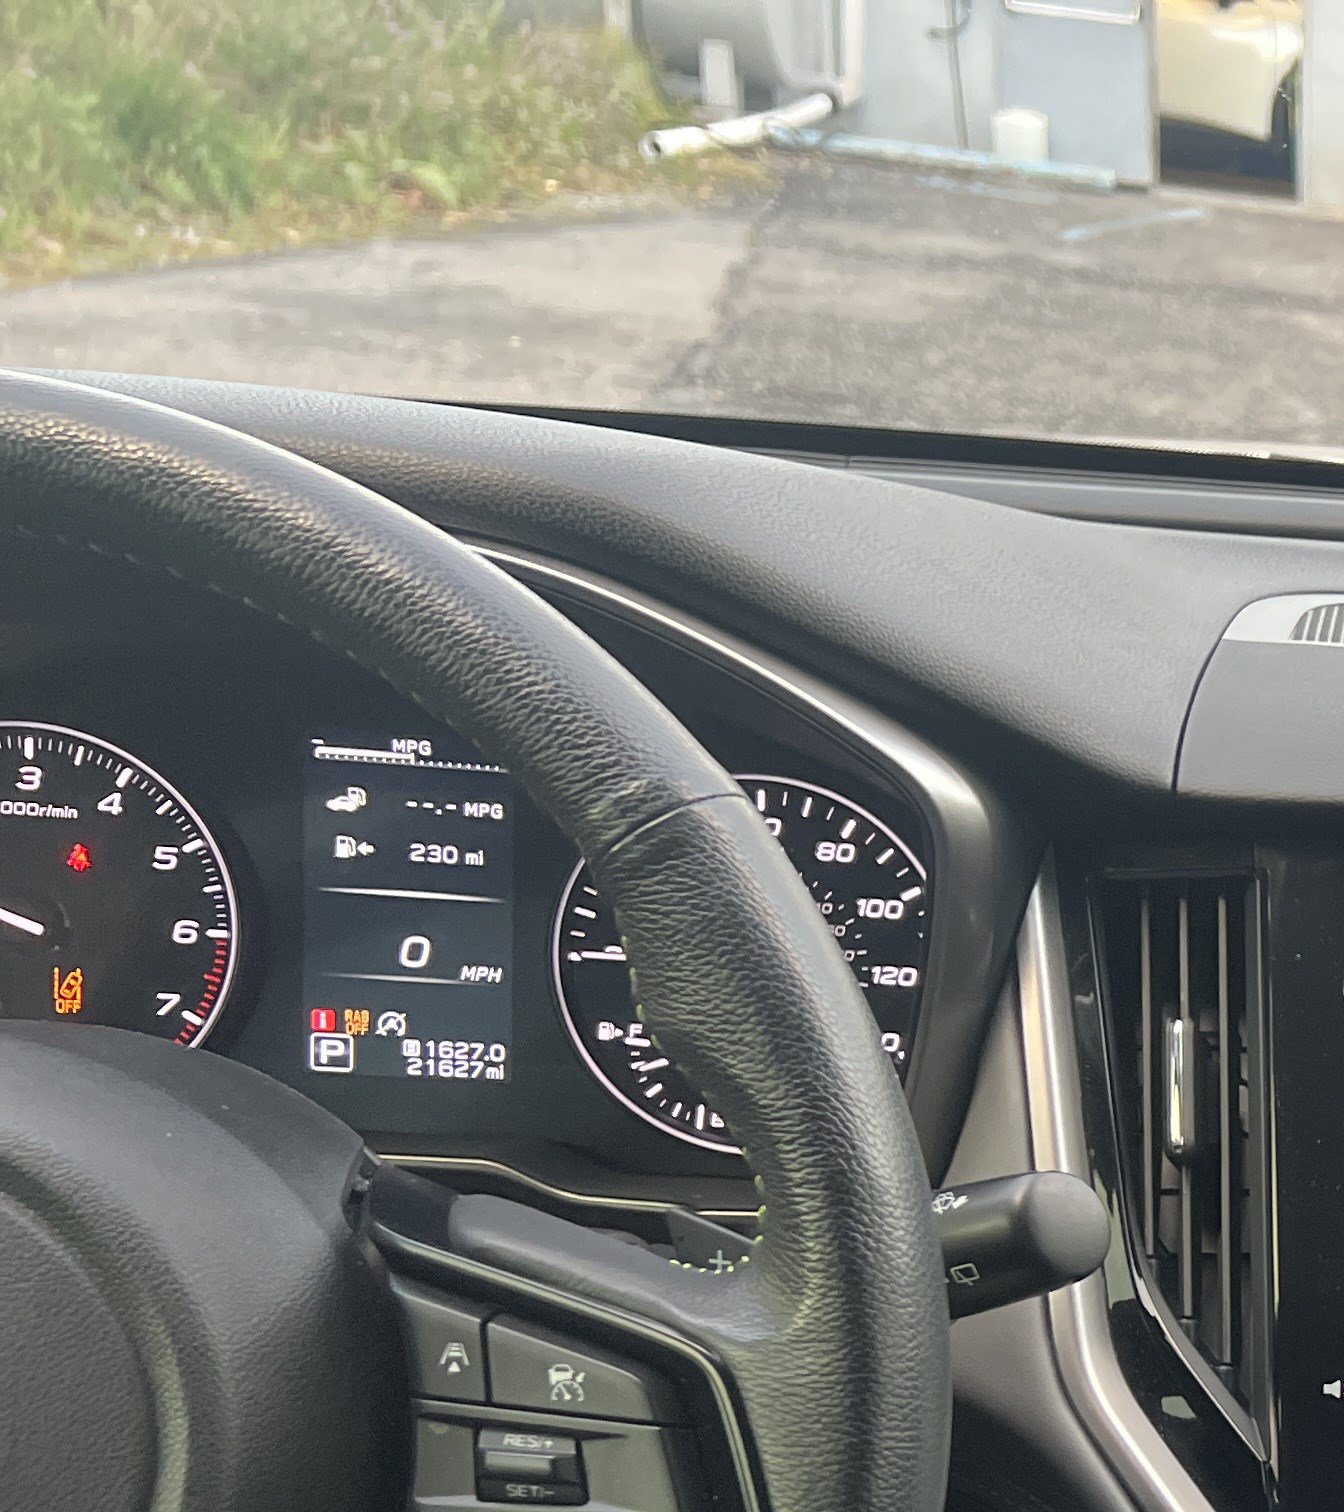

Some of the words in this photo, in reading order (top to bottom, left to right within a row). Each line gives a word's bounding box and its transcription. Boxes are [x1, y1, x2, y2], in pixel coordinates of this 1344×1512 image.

[391, 739, 432, 757] MPG
[15, 766, 42, 791] 3
[0, 800, 79, 819] 000r/min
[97, 792, 123, 816] 4
[463, 802, 504, 820] MPG
[153, 846, 179, 871] 5
[409, 841, 458, 865] 230
[465, 848, 485, 866] mi
[816, 842, 856, 864] 80
[857, 898, 905, 920] 100
[172, 919, 199, 944] 6
[399, 935, 431, 968] 0
[460, 965, 504, 984] MPH
[872, 966, 918, 987] 120
[55, 998, 82, 1014] OFF
[155, 993, 181, 1016] 7
[344, 1009, 370, 1024] RAB
[346, 1022, 370, 1036] OFF
[629, 1023, 644, 1038] F
[319, 1039, 346, 1065] P
[426, 1040, 507, 1063] 1627.0
